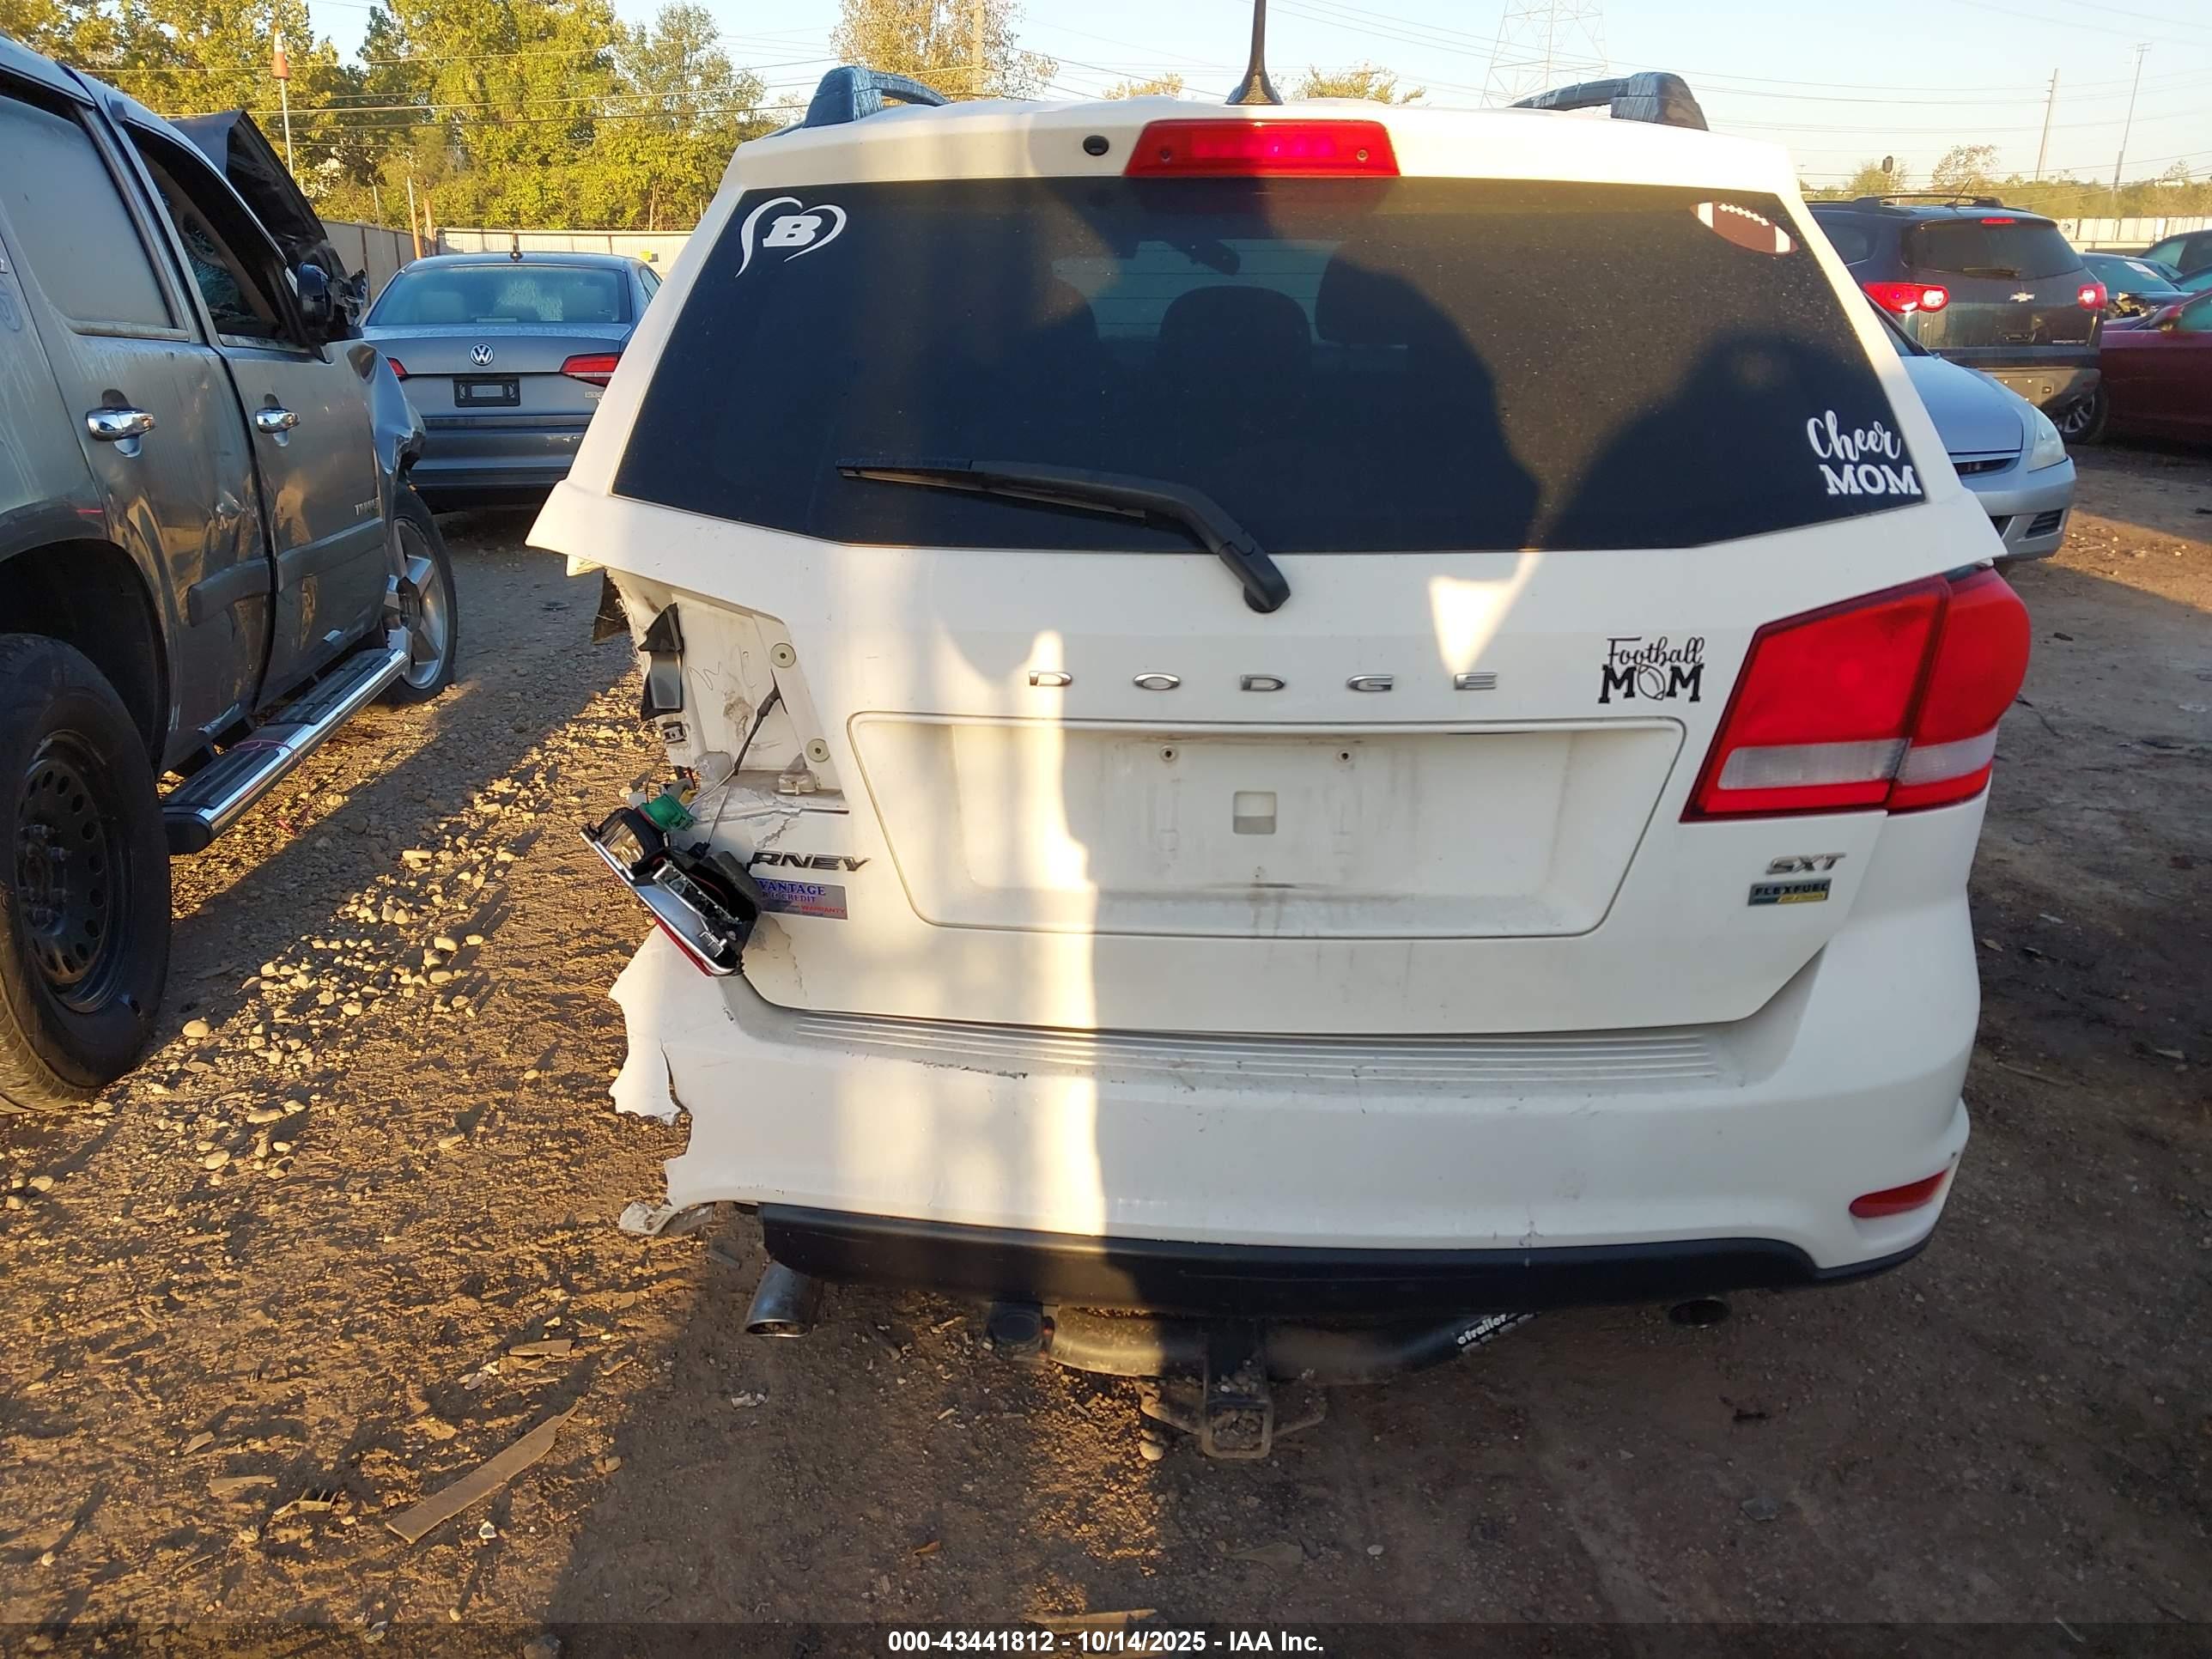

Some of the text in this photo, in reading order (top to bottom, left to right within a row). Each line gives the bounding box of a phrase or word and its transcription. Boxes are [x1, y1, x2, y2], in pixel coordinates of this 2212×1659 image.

[763, 216, 822, 247] B
[471, 344, 493, 365] VW
[1807, 410, 1901, 461] Cheer
[1819, 464, 1923, 495] MOM
[1607, 635, 1705, 667] Football
[1029, 671, 1498, 691] DODGE
[1765, 852, 1846, 874] SXT
[781, 893, 817, 902] CREDIT
[800, 905, 846, 914] WARRANTY
